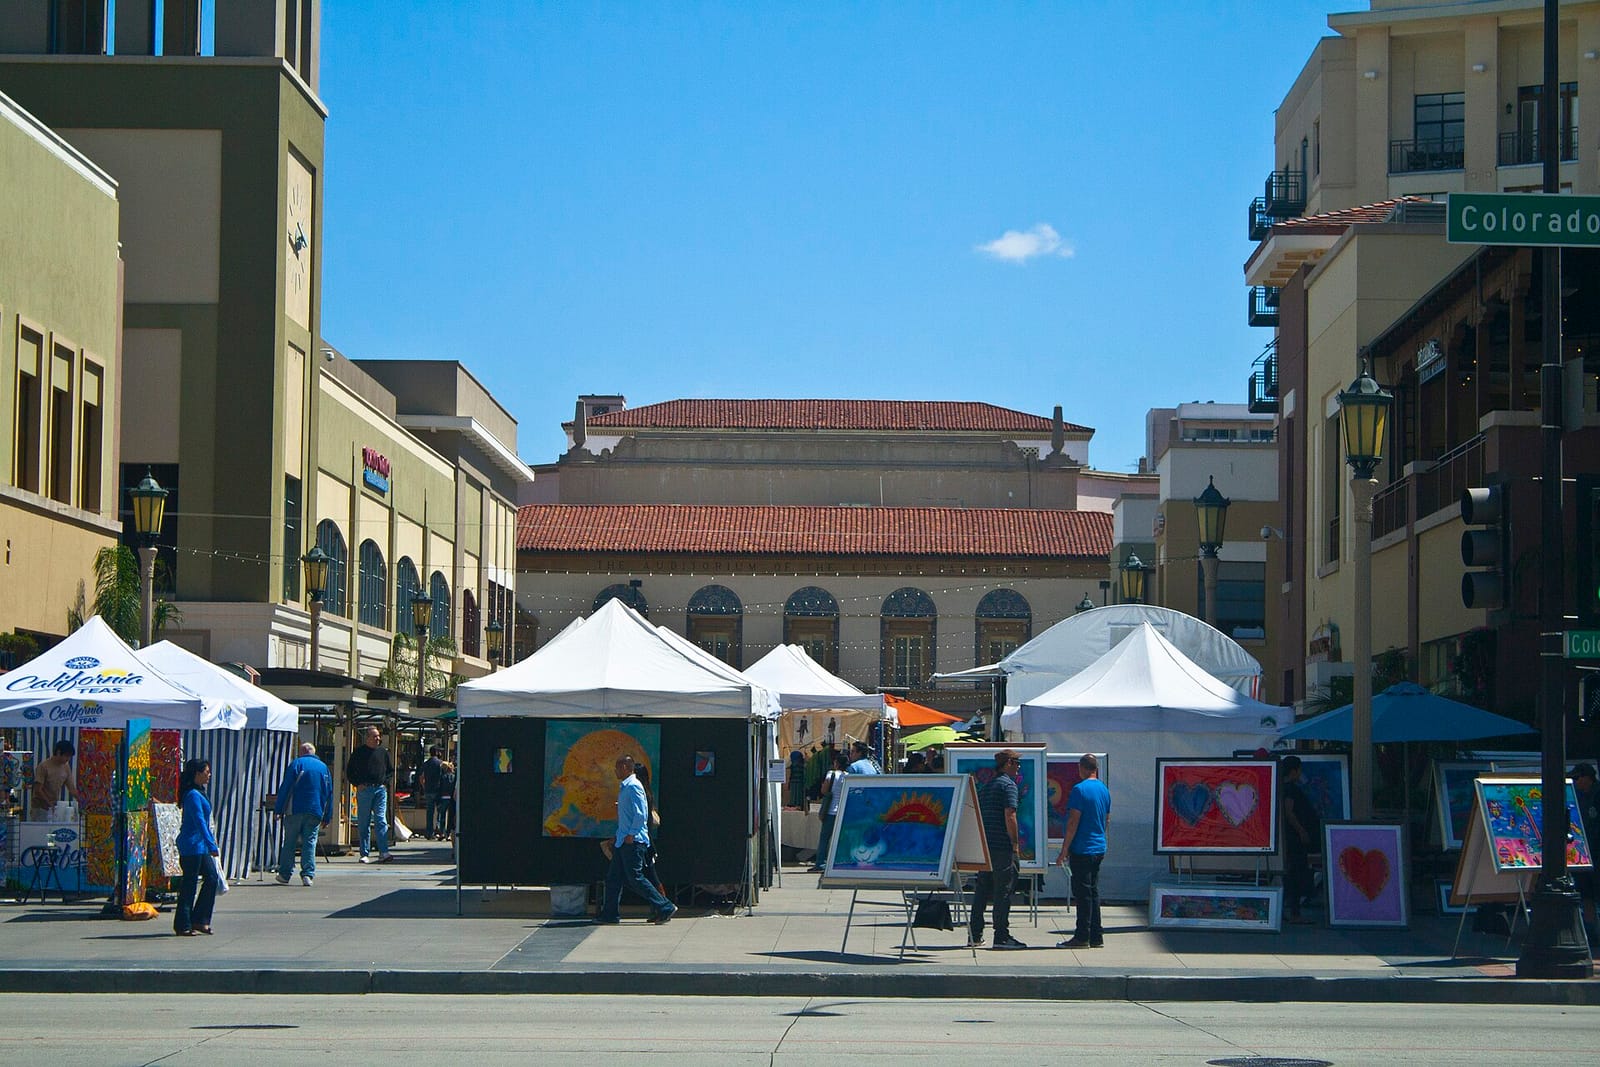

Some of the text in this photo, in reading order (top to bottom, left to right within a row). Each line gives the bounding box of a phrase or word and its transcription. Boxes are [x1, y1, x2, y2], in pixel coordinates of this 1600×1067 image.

[1461, 205, 1600, 234] Colorado
[597, 560, 625, 570] THE
[643, 560, 757, 572] AUDITORIUM
[6, 670, 144, 692] California
[49, 703, 104, 722] California
[79, 716, 98, 724] TEAS
